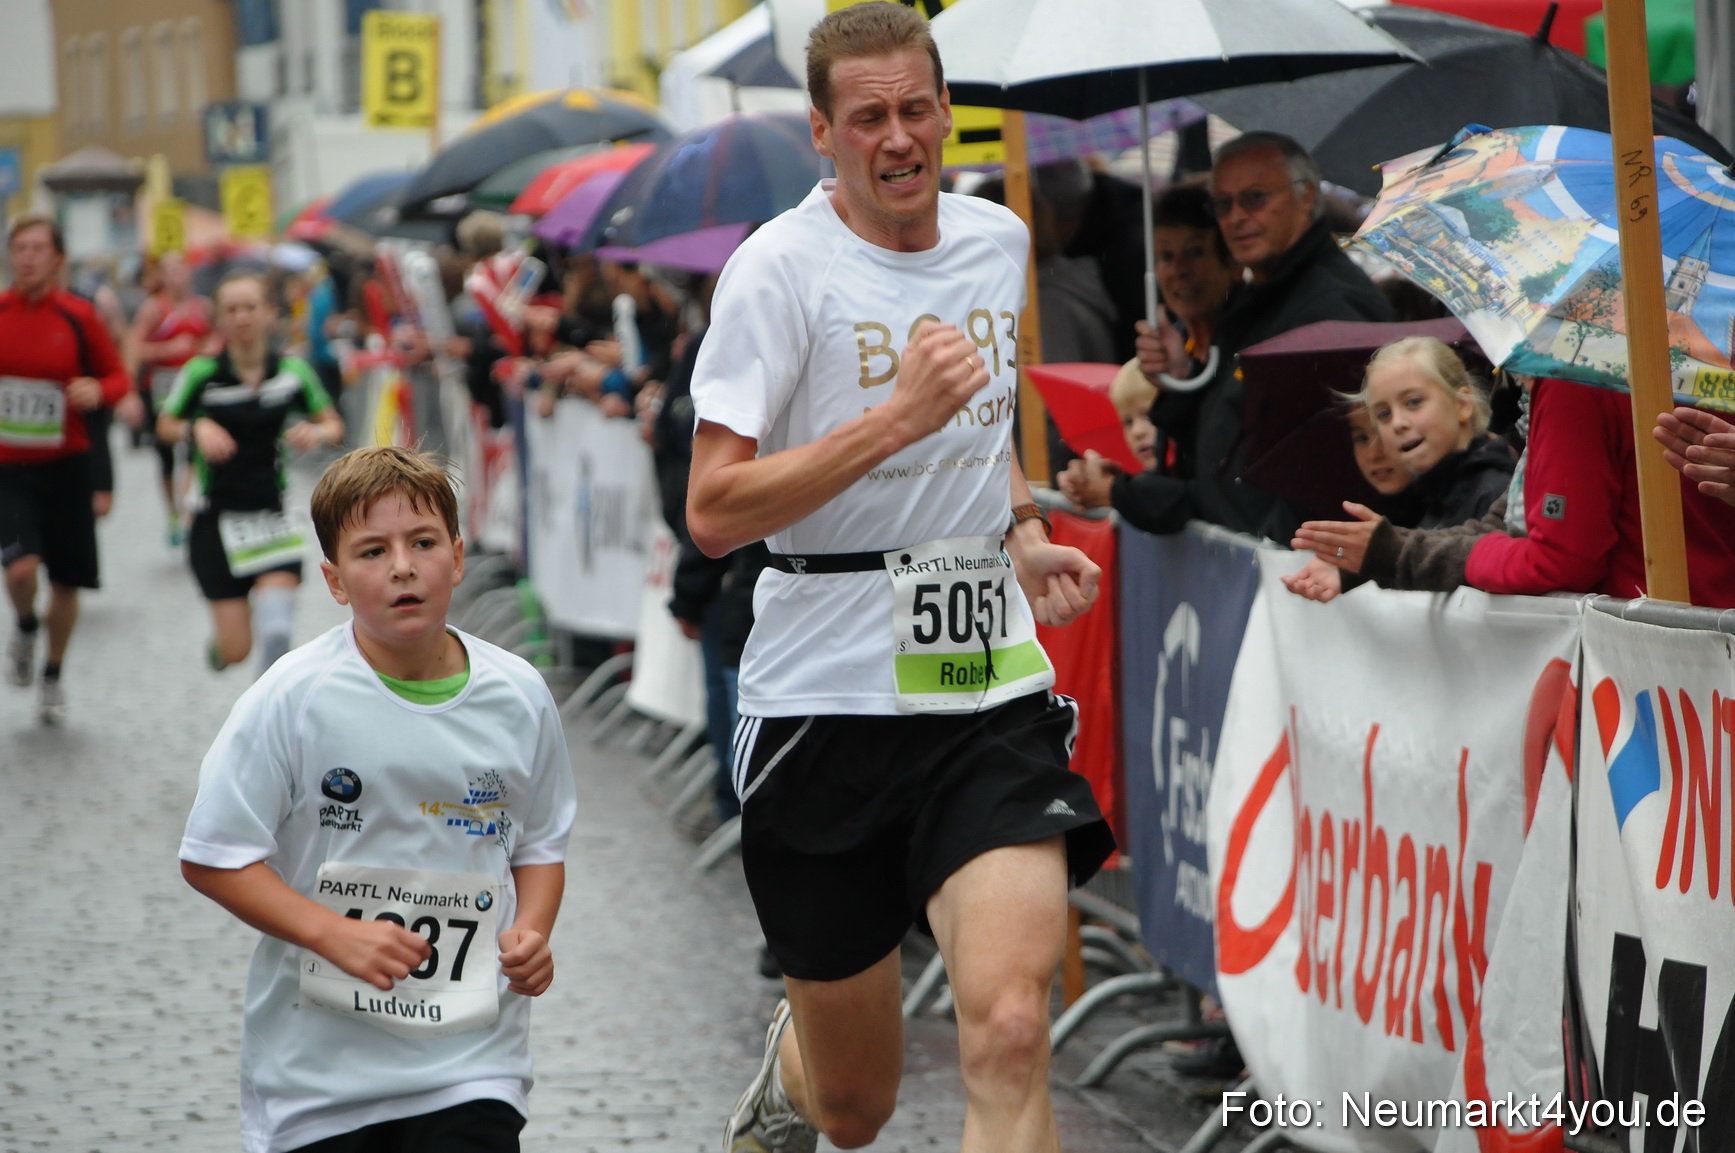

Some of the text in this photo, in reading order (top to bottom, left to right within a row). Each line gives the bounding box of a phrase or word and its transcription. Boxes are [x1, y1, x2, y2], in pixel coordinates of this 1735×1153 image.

[385, 50, 421, 105] B
[1621, 149, 1652, 188] NR
[893, 557, 952, 577] PARTL
[912, 577, 1008, 645] 5051
[319, 804, 364, 822] PARTL
[418, 801, 445, 816] 14.
[319, 880, 469, 908] PARTL Neumarkt
[308, 962, 316, 973] J
[354, 990, 442, 1022] Ludwig
